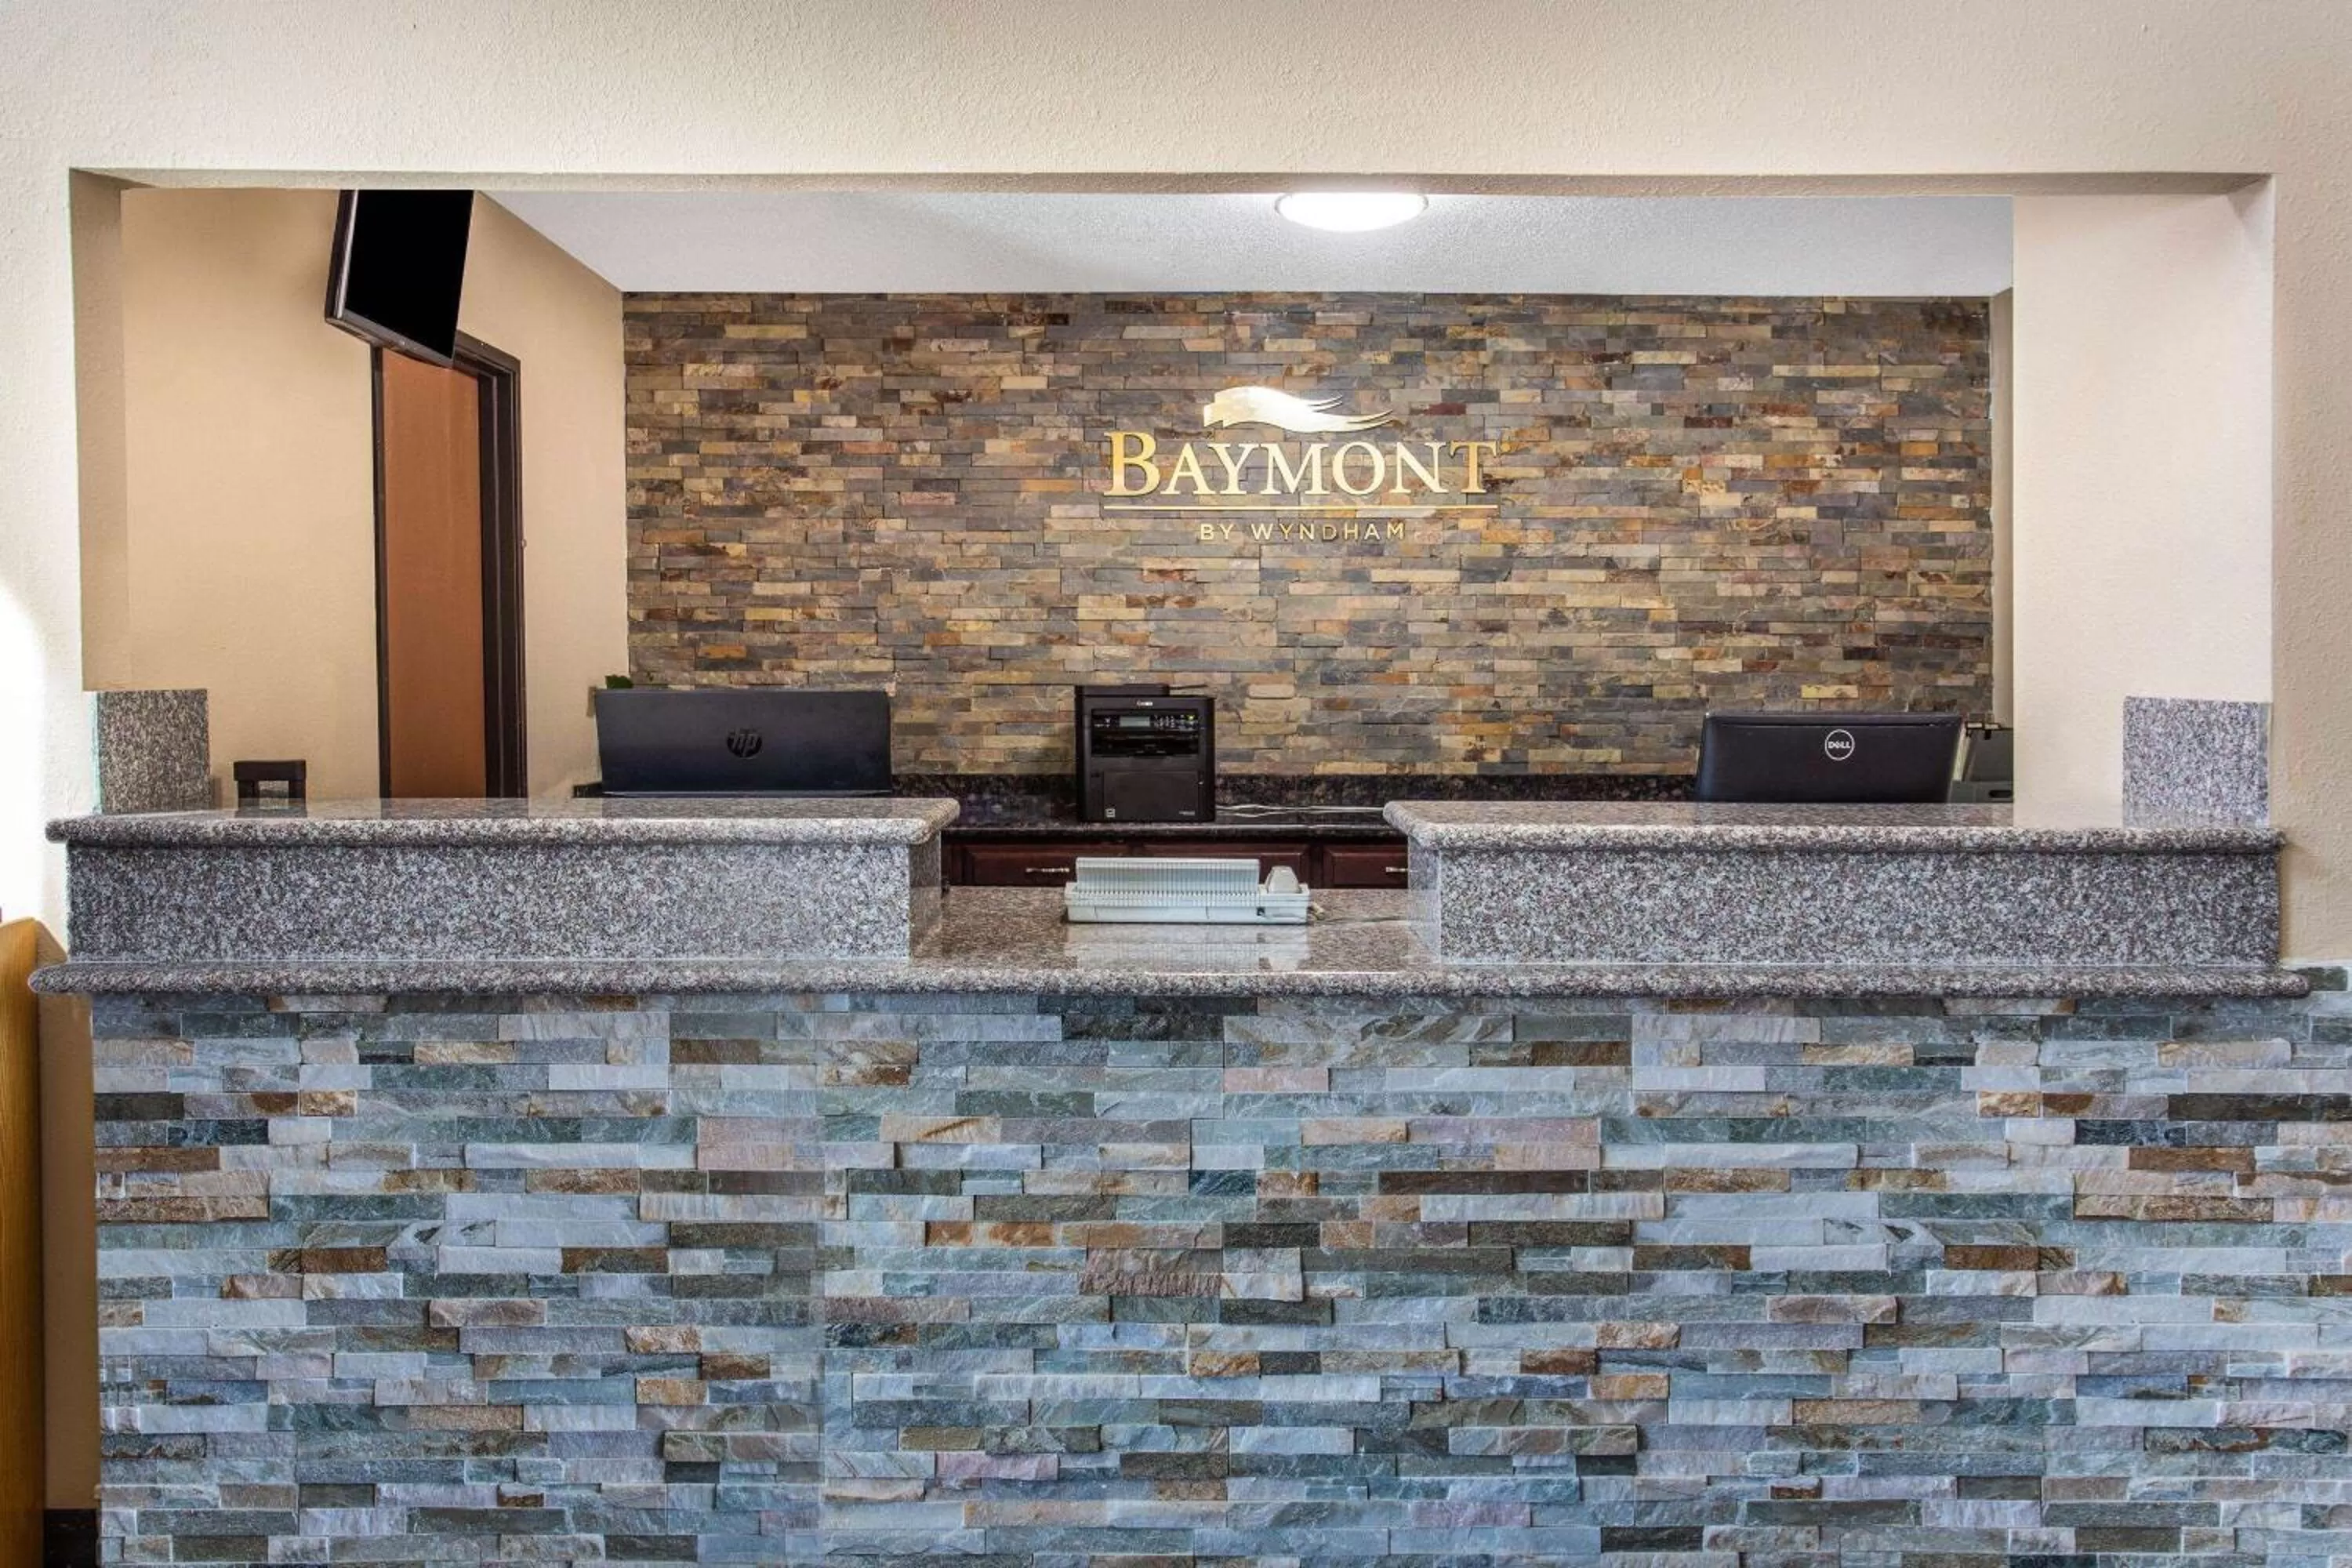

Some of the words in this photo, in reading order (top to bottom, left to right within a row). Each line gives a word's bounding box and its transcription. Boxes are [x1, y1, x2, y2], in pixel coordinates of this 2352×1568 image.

[1103, 432, 1497, 496] BAYMONT
[1200, 523, 1234, 541] BY
[1251, 523, 1404, 542] WYNDHAM
